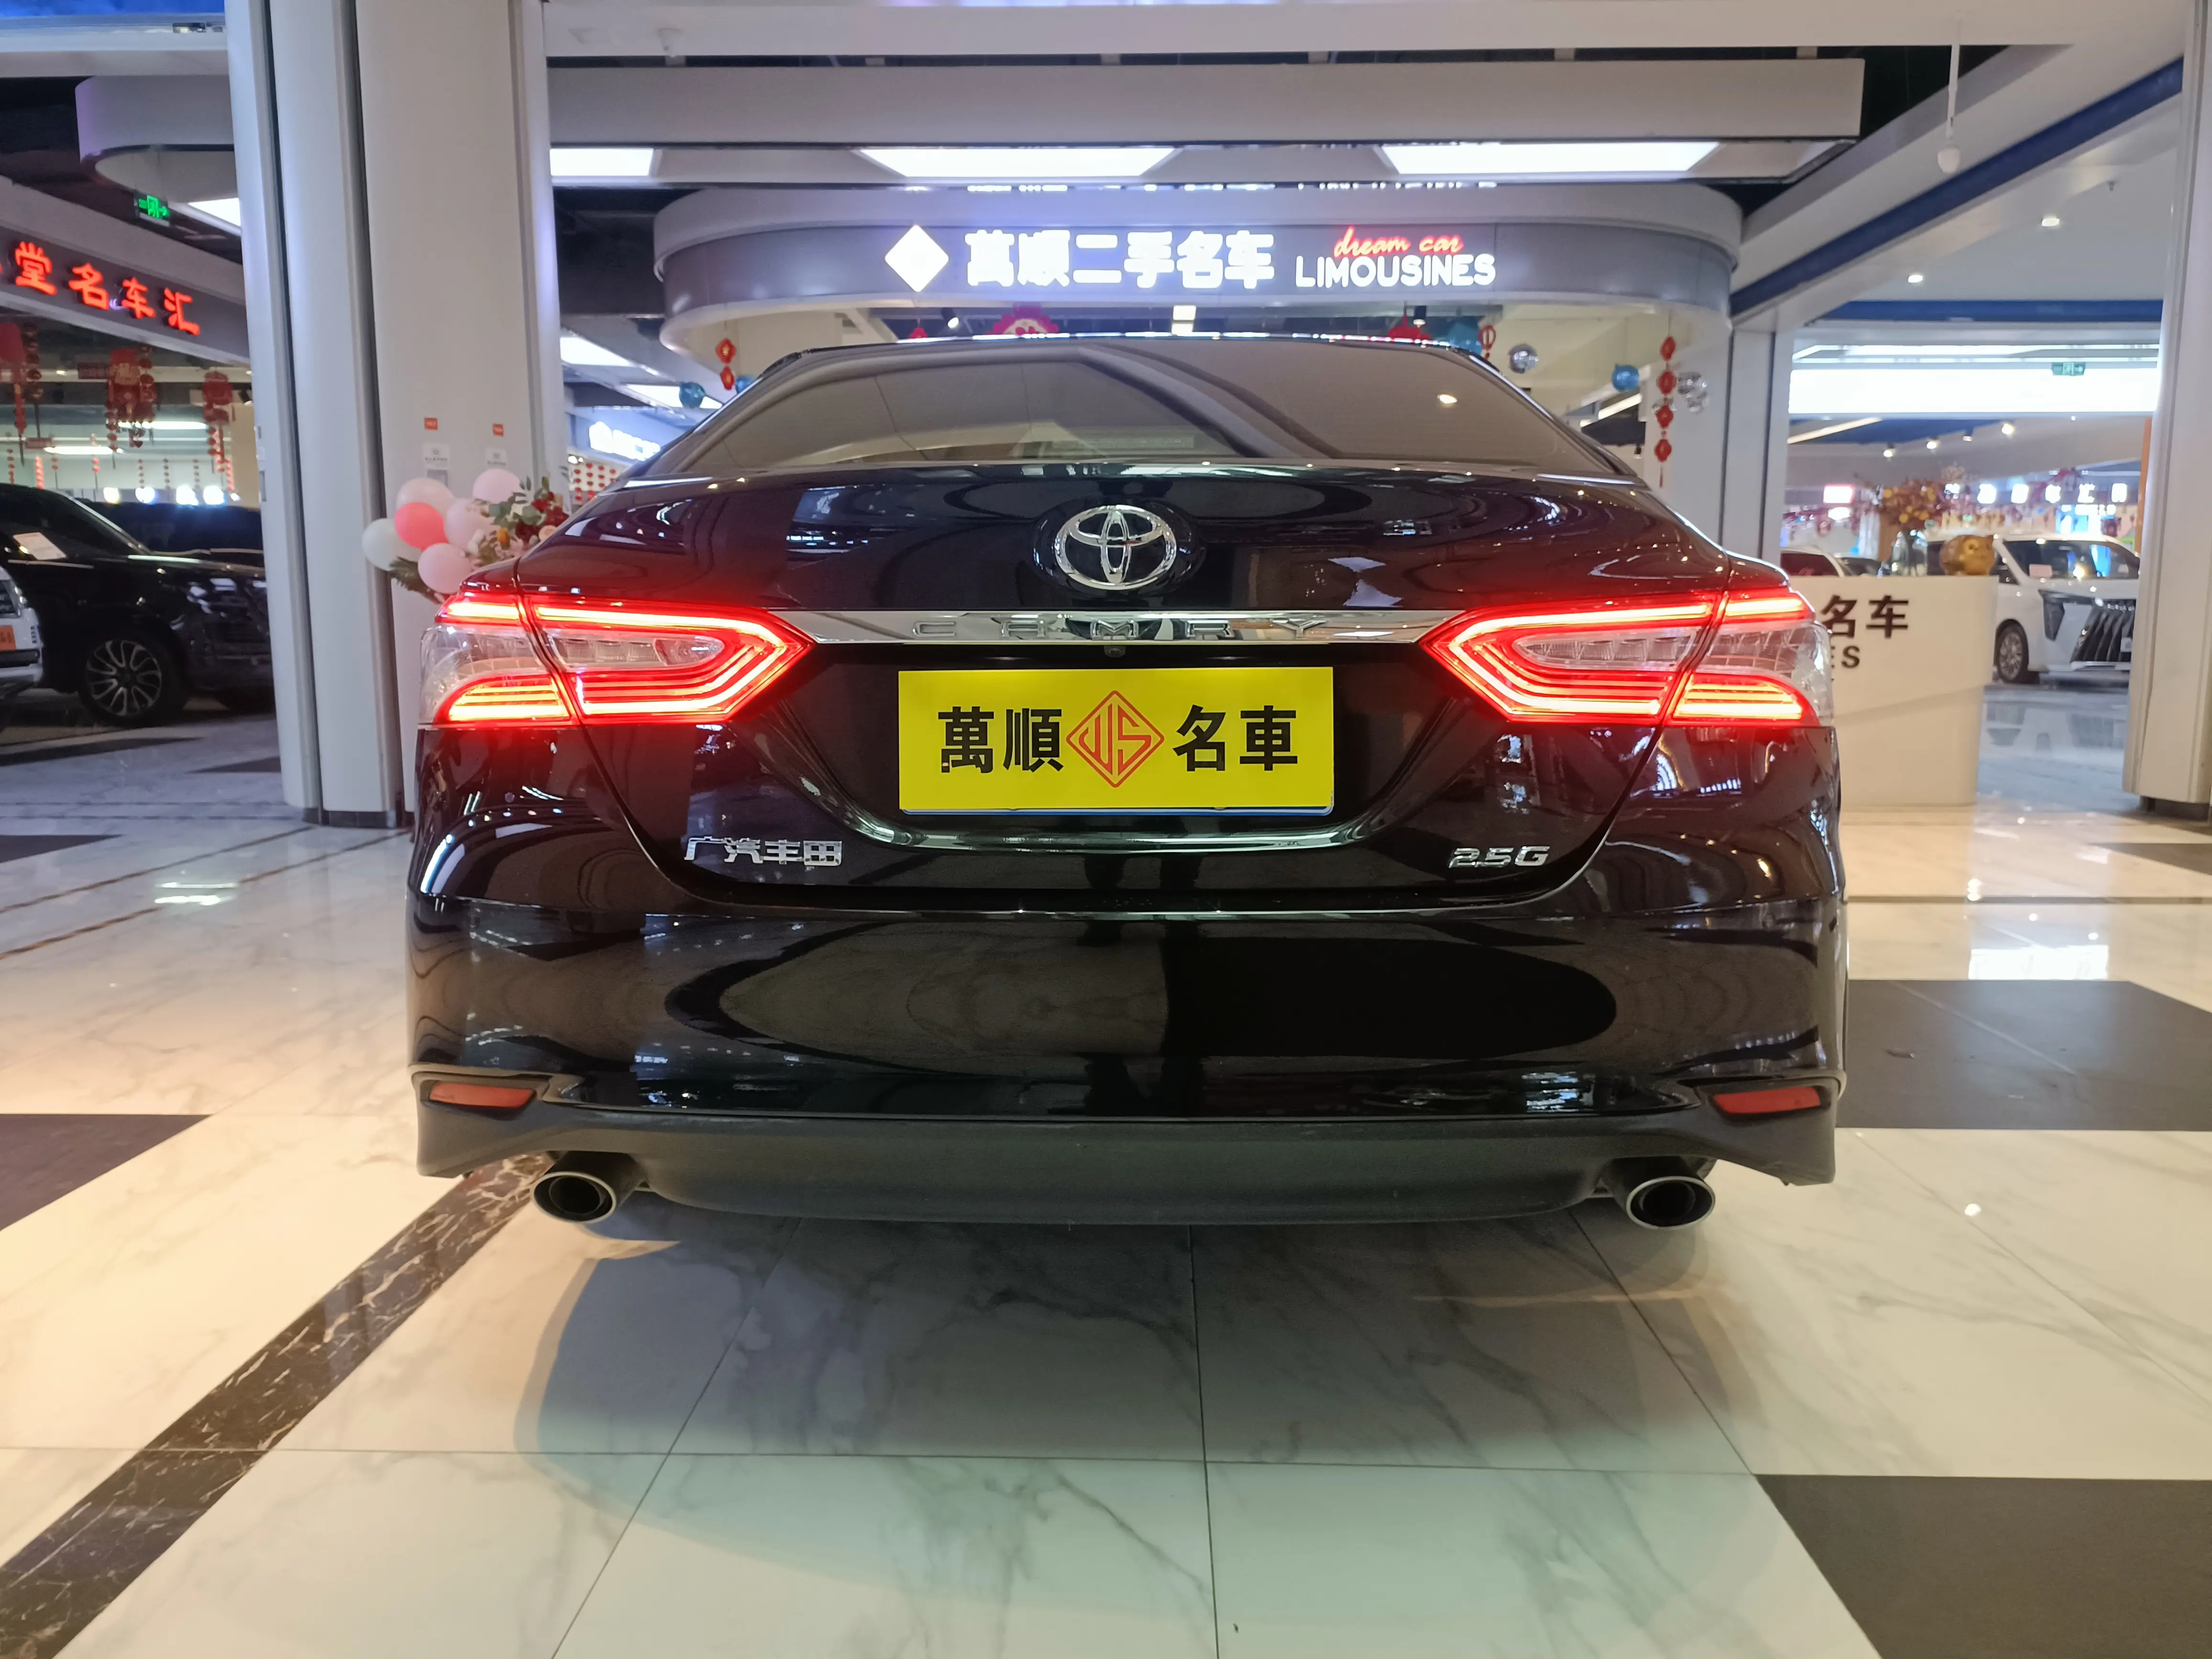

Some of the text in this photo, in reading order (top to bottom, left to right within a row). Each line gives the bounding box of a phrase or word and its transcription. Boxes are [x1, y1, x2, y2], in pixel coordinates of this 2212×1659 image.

[1333, 225, 1464, 259] dream car
[1295, 254, 1496, 288] LIMOUSINES
[0, 241, 201, 336] 堂名车汇
[912, 618, 1329, 639] CAMRY
[1172, 704, 1298, 772] 名車
[684, 836, 843, 867] 广汽丰田
[1448, 845, 1551, 869] 2.5G
